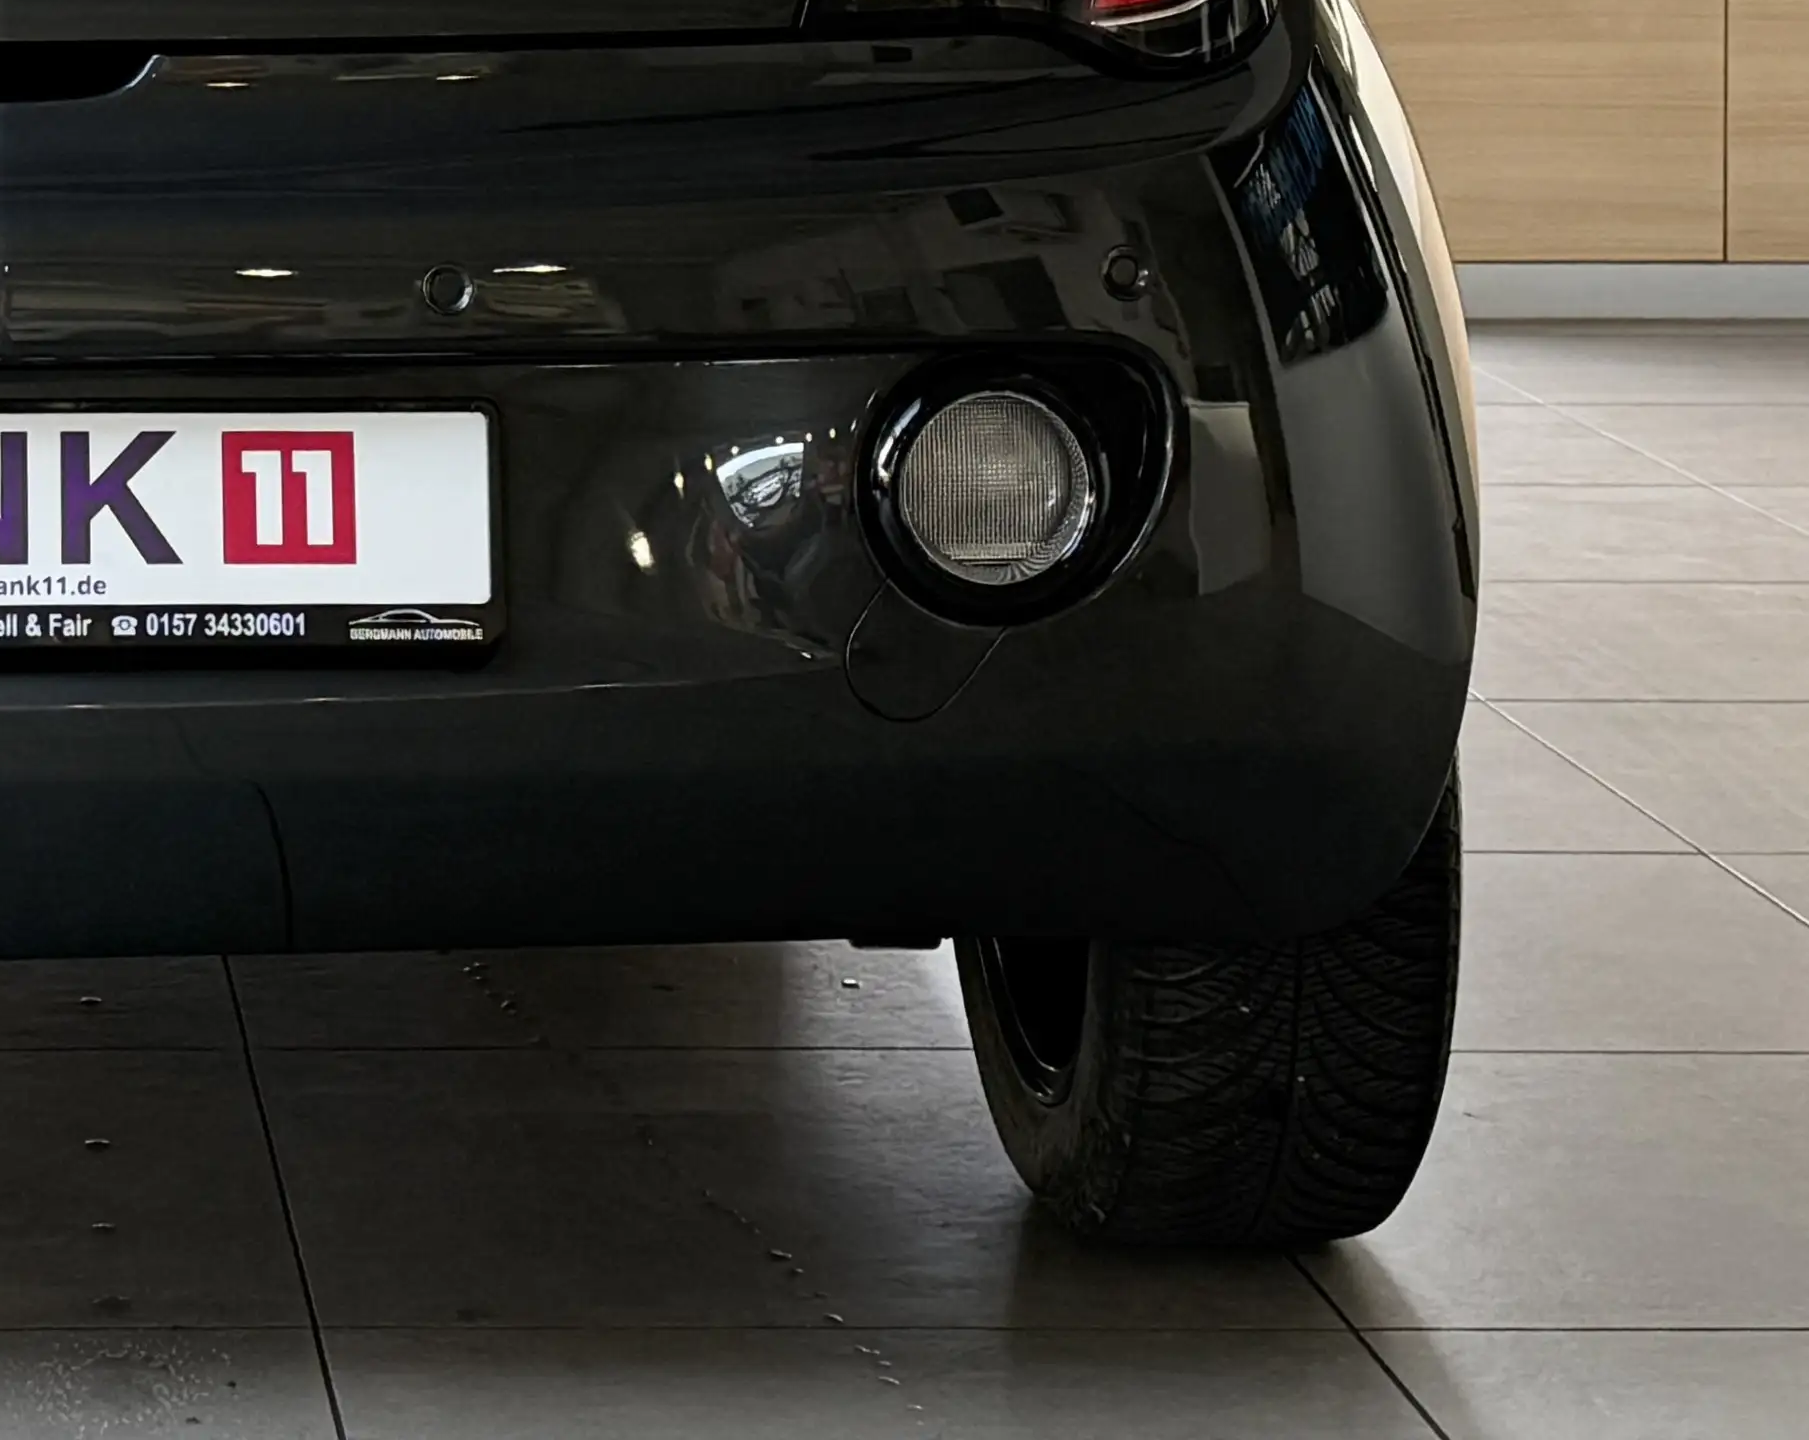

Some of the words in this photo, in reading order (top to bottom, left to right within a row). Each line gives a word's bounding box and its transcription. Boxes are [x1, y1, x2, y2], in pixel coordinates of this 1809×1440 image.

[239, 448, 336, 548] 11
[24, 613, 42, 637] &
[48, 612, 93, 637] Fair
[145, 612, 198, 637] 0157
[204, 612, 307, 637] 34330601
[413, 627, 484, 641] AUTOMOBILE
